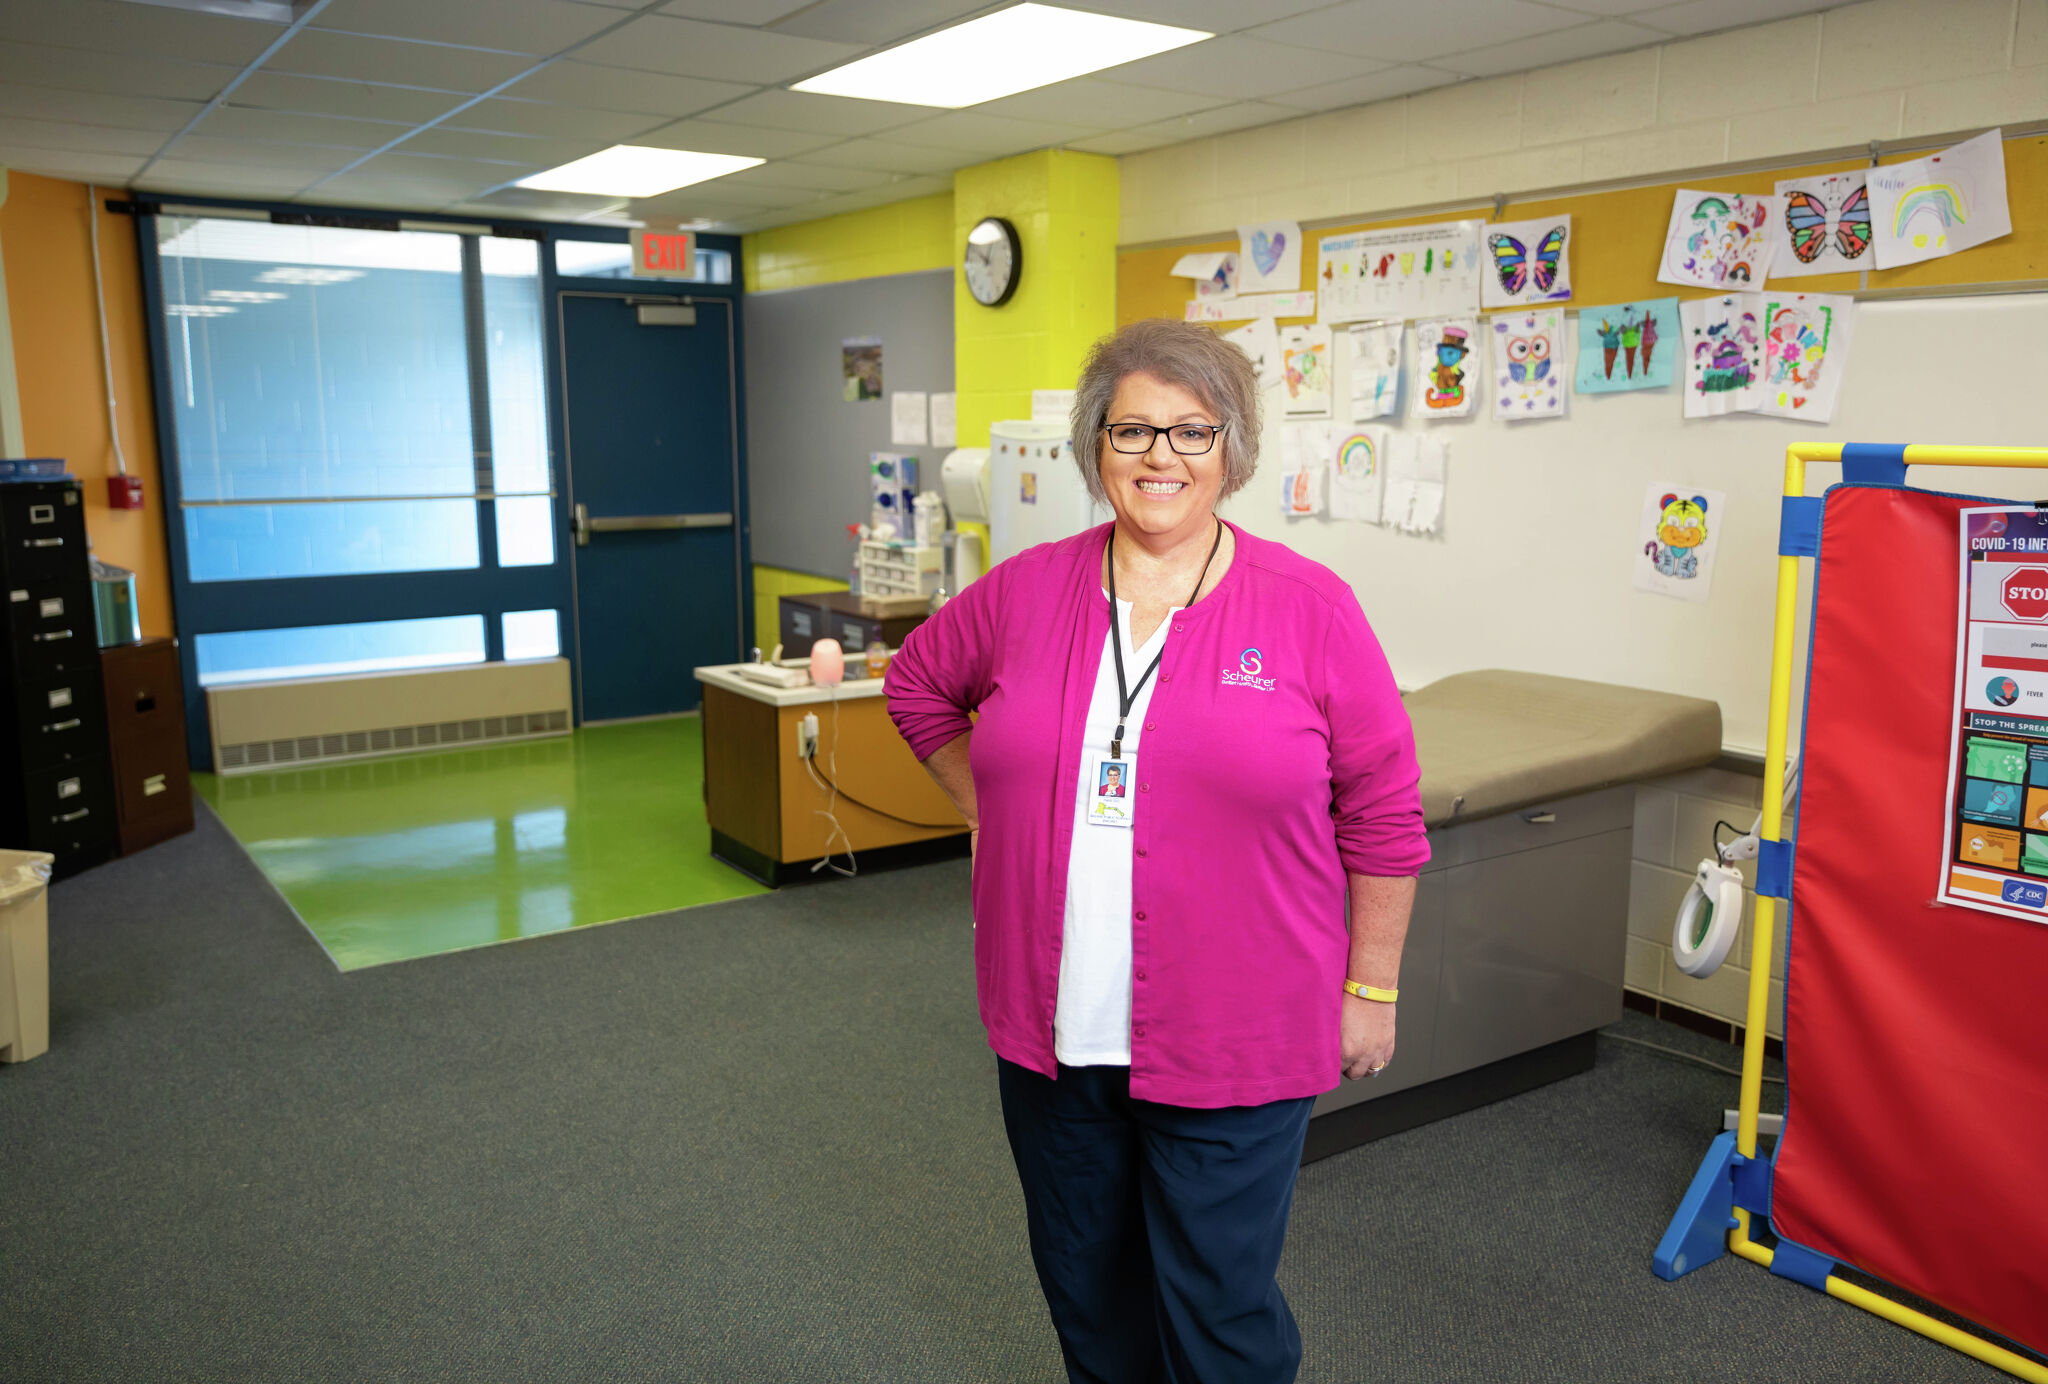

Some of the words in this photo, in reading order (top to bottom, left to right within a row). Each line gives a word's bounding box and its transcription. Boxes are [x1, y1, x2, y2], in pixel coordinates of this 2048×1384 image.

[643, 232, 688, 271] EXIT
[1971, 537, 2025, 550] COVID-19
[2028, 537, 2048, 550] INF
[2031, 641, 2048, 649] please
[1222, 669, 1276, 687] Scheurer
[2026, 690, 2044, 698] FEVER
[1974, 718, 1997, 727] STOP
[1999, 720, 2016, 730] THE
[2026, 890, 2043, 900] CDC
